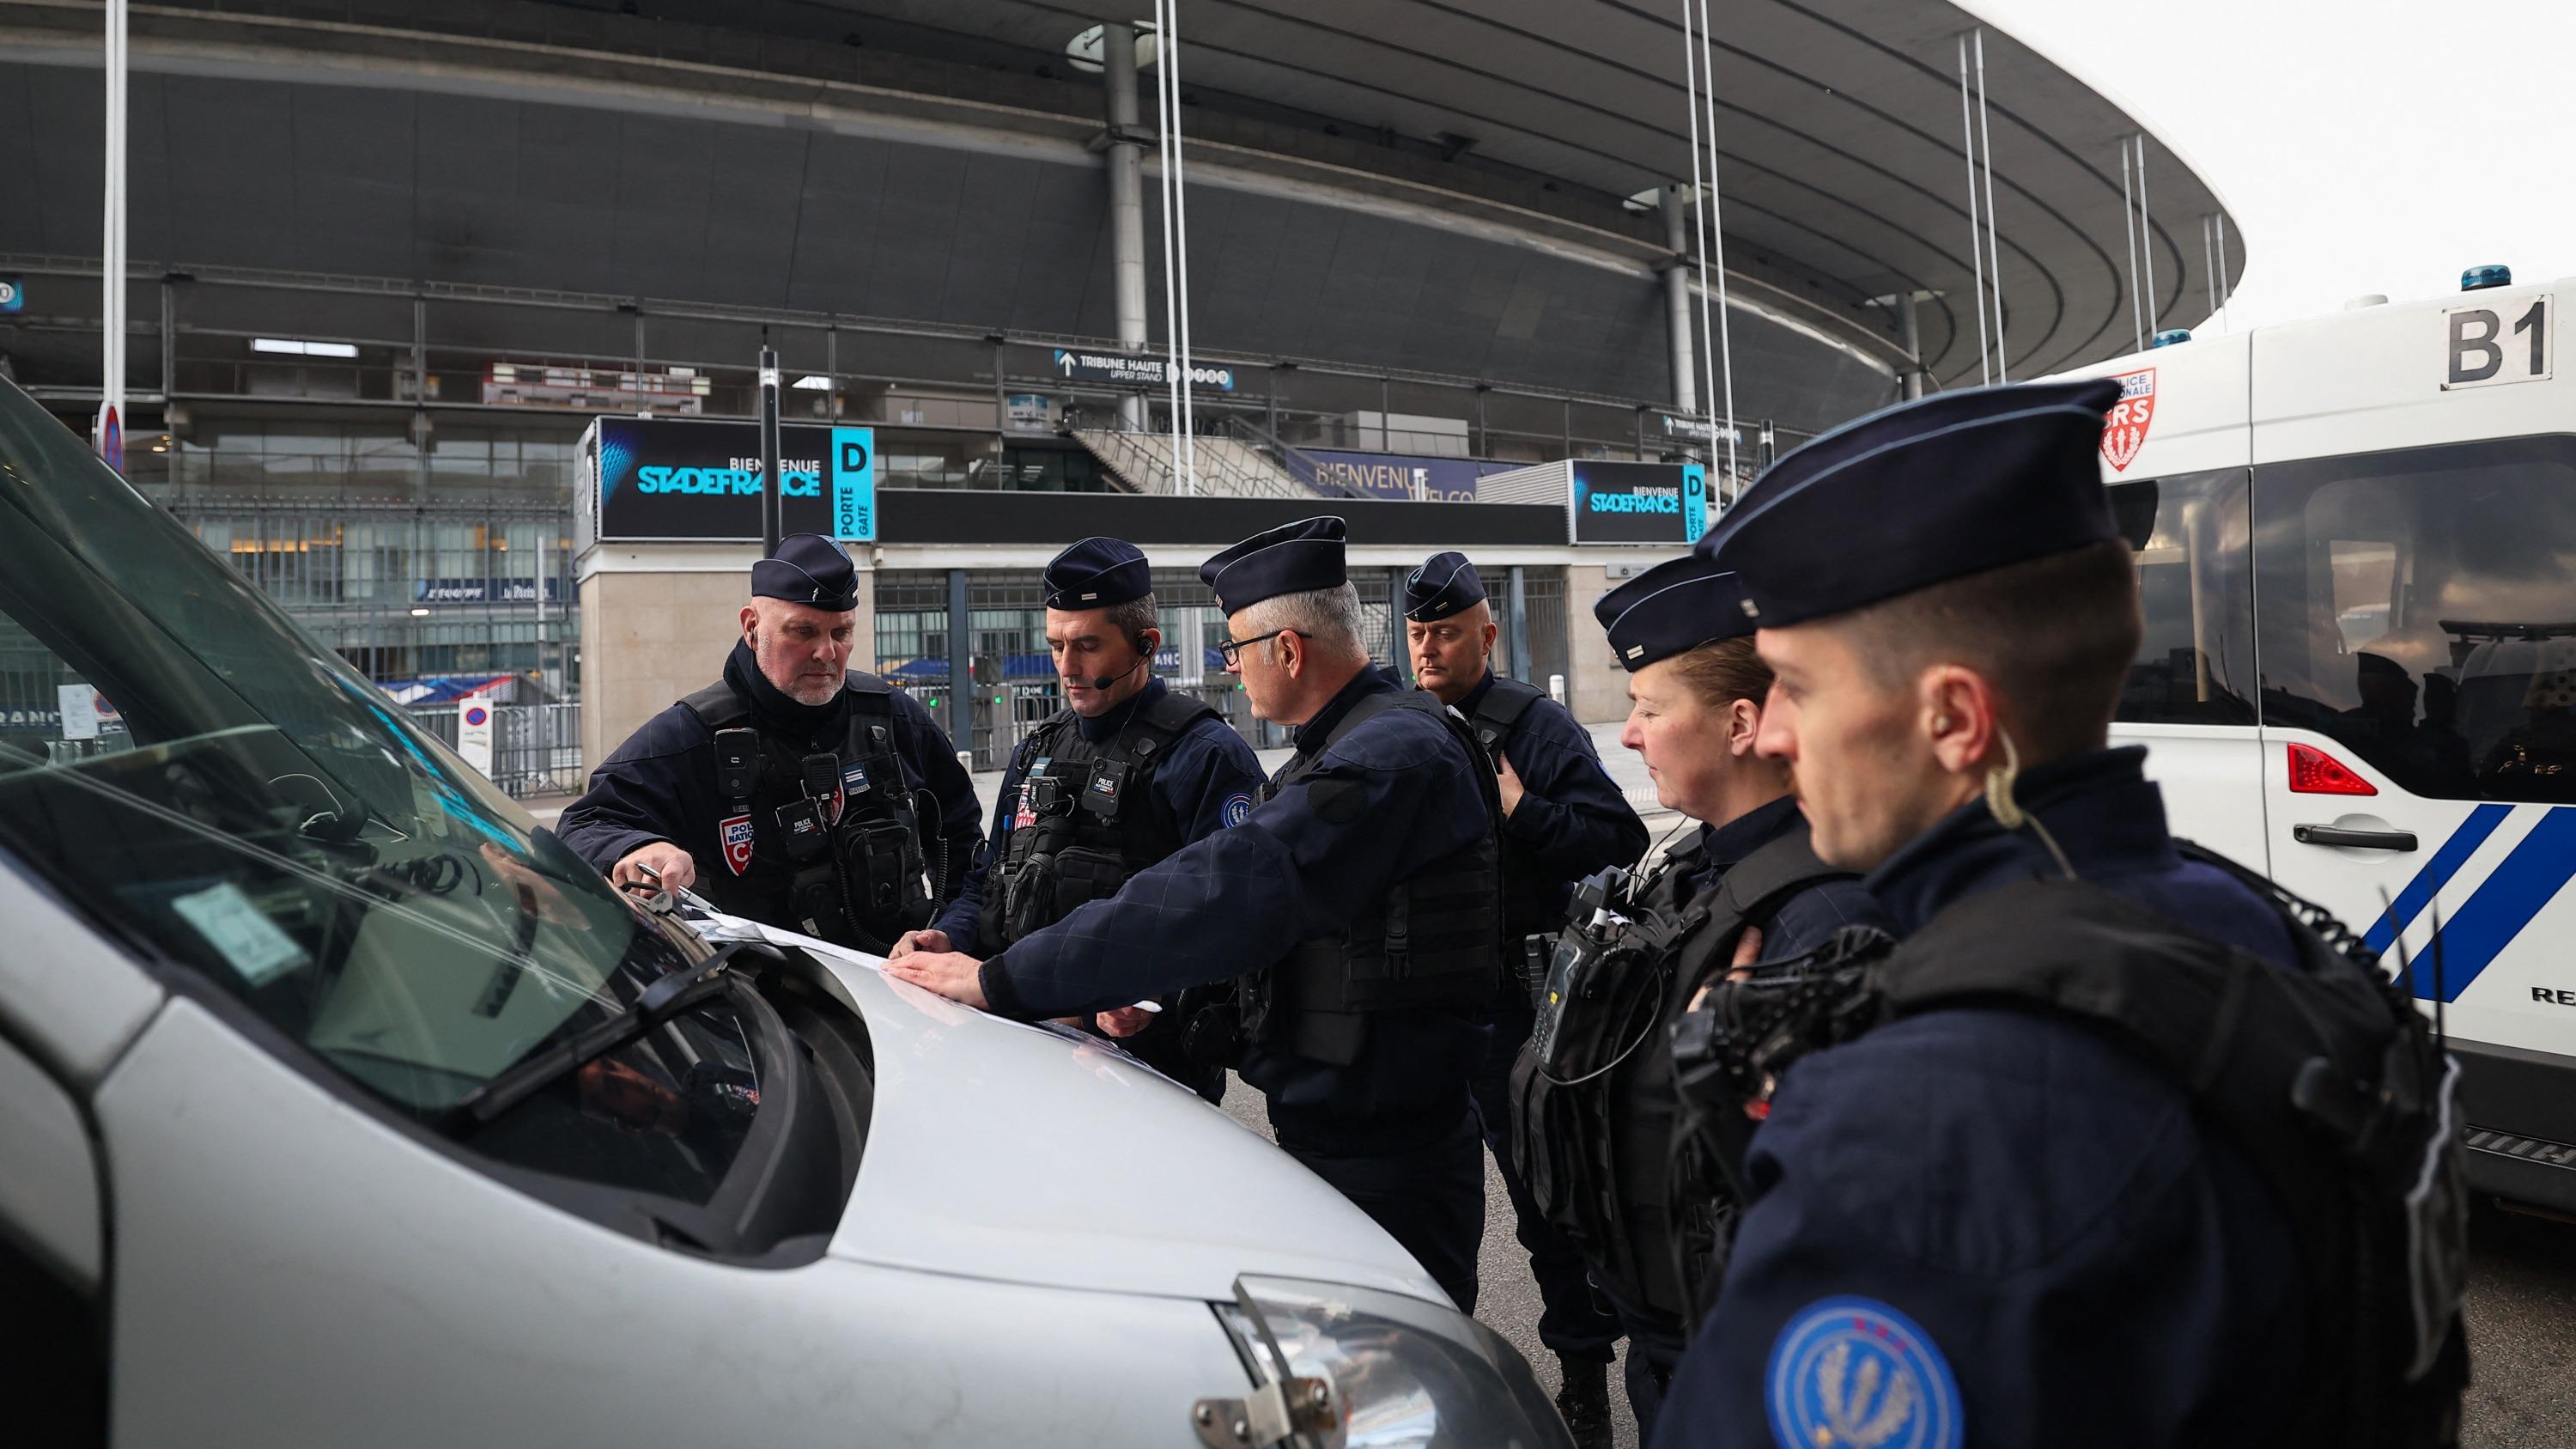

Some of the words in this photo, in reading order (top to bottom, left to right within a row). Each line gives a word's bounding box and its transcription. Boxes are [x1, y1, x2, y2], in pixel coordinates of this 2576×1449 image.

[2449, 301, 2544, 383] B1
[1080, 355, 1126, 369] TRIBUNE
[1127, 360, 1162, 372] HAUTE
[1110, 370, 1134, 380] UPPER
[1136, 372, 1162, 381] STAND
[2118, 374, 2147, 388] LICE
[2118, 384, 2151, 399] ONALE
[729, 458, 820, 472] BIENENUE
[841, 442, 866, 472] D
[1633, 486, 1679, 496] BIENVENUE
[1688, 475, 1701, 496] D
[841, 487, 854, 536] PORTE
[1591, 493, 1680, 514] STADEFRANCE
[859, 505, 868, 536] GATE
[1098, 777, 1114, 787] POLICE
[794, 818, 811, 828] POLICE
[2531, 987, 2576, 1006] RE
